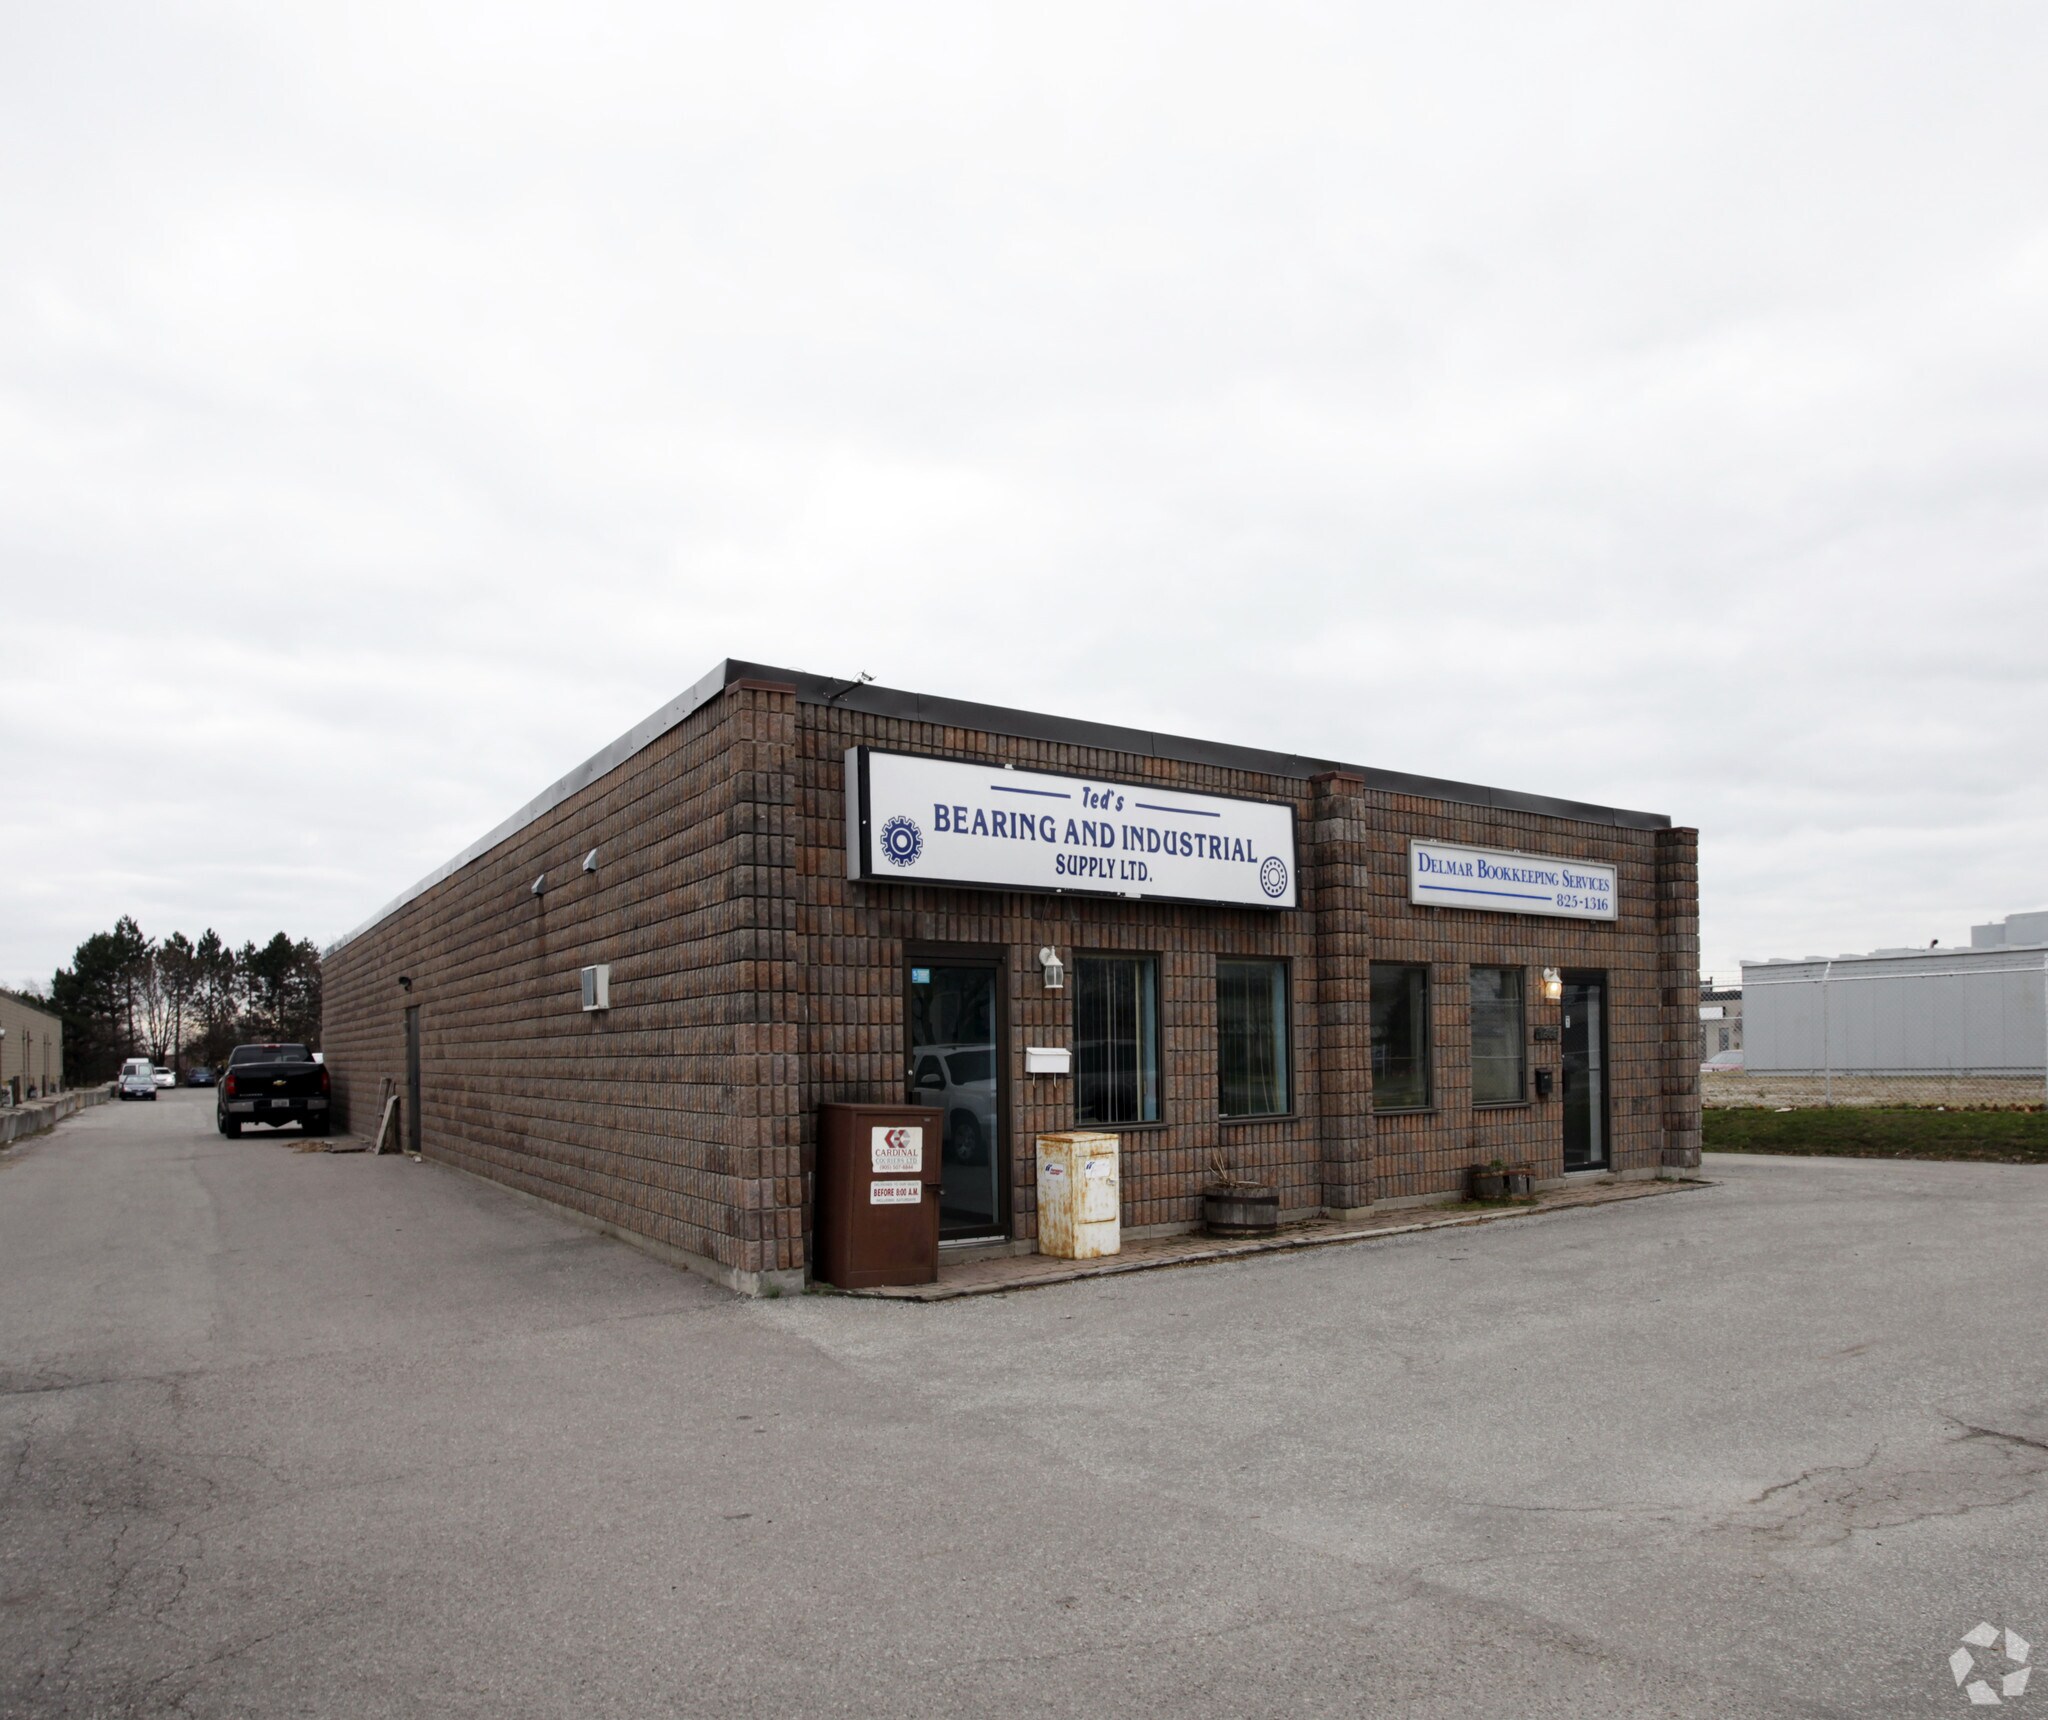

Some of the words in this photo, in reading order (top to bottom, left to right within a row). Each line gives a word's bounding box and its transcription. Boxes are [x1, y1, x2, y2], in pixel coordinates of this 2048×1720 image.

[1082, 786, 1125, 812] Ted's
[933, 803, 1057, 844] BEARING
[1063, 818, 1116, 849] AND
[1121, 825, 1258, 864] INDUSTRIAL
[1055, 853, 1117, 880] SUPPLY
[1120, 859, 1153, 882] LTD.
[1556, 893, 1609, 911] 825-1316
[875, 1148, 919, 1157] CARDINAL
[873, 1188, 894, 1197] BEFORE
